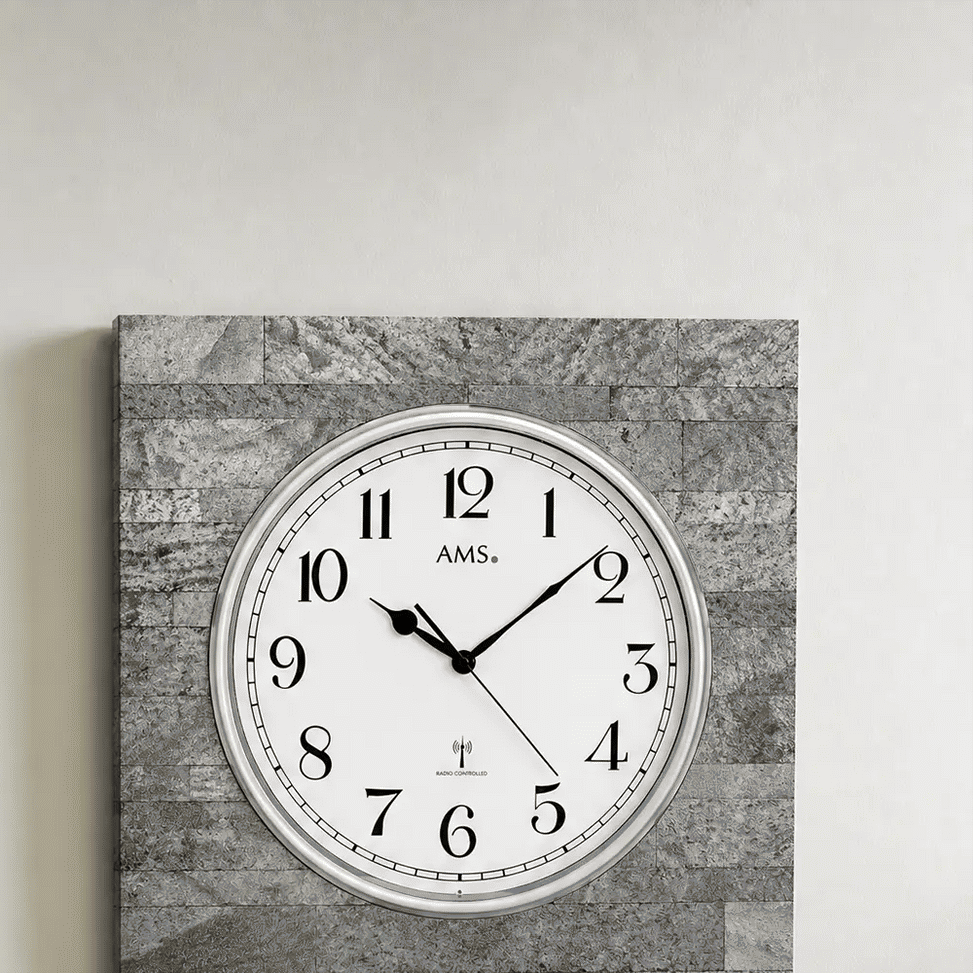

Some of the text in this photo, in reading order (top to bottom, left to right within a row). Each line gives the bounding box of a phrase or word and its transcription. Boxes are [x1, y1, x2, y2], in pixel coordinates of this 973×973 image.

[360, 489, 391, 539] 11
[444, 466, 493, 518] 12
[543, 488, 555, 537] 1
[299, 549, 347, 602] 10
[593, 551, 628, 603] 2
[270, 636, 305, 689] 9
[624, 643, 658, 694] 3
[300, 726, 332, 780] 8
[585, 720, 628, 770] 4
[365, 789, 402, 835] 7
[440, 805, 476, 858] 6
[531, 783, 565, 834] 5
